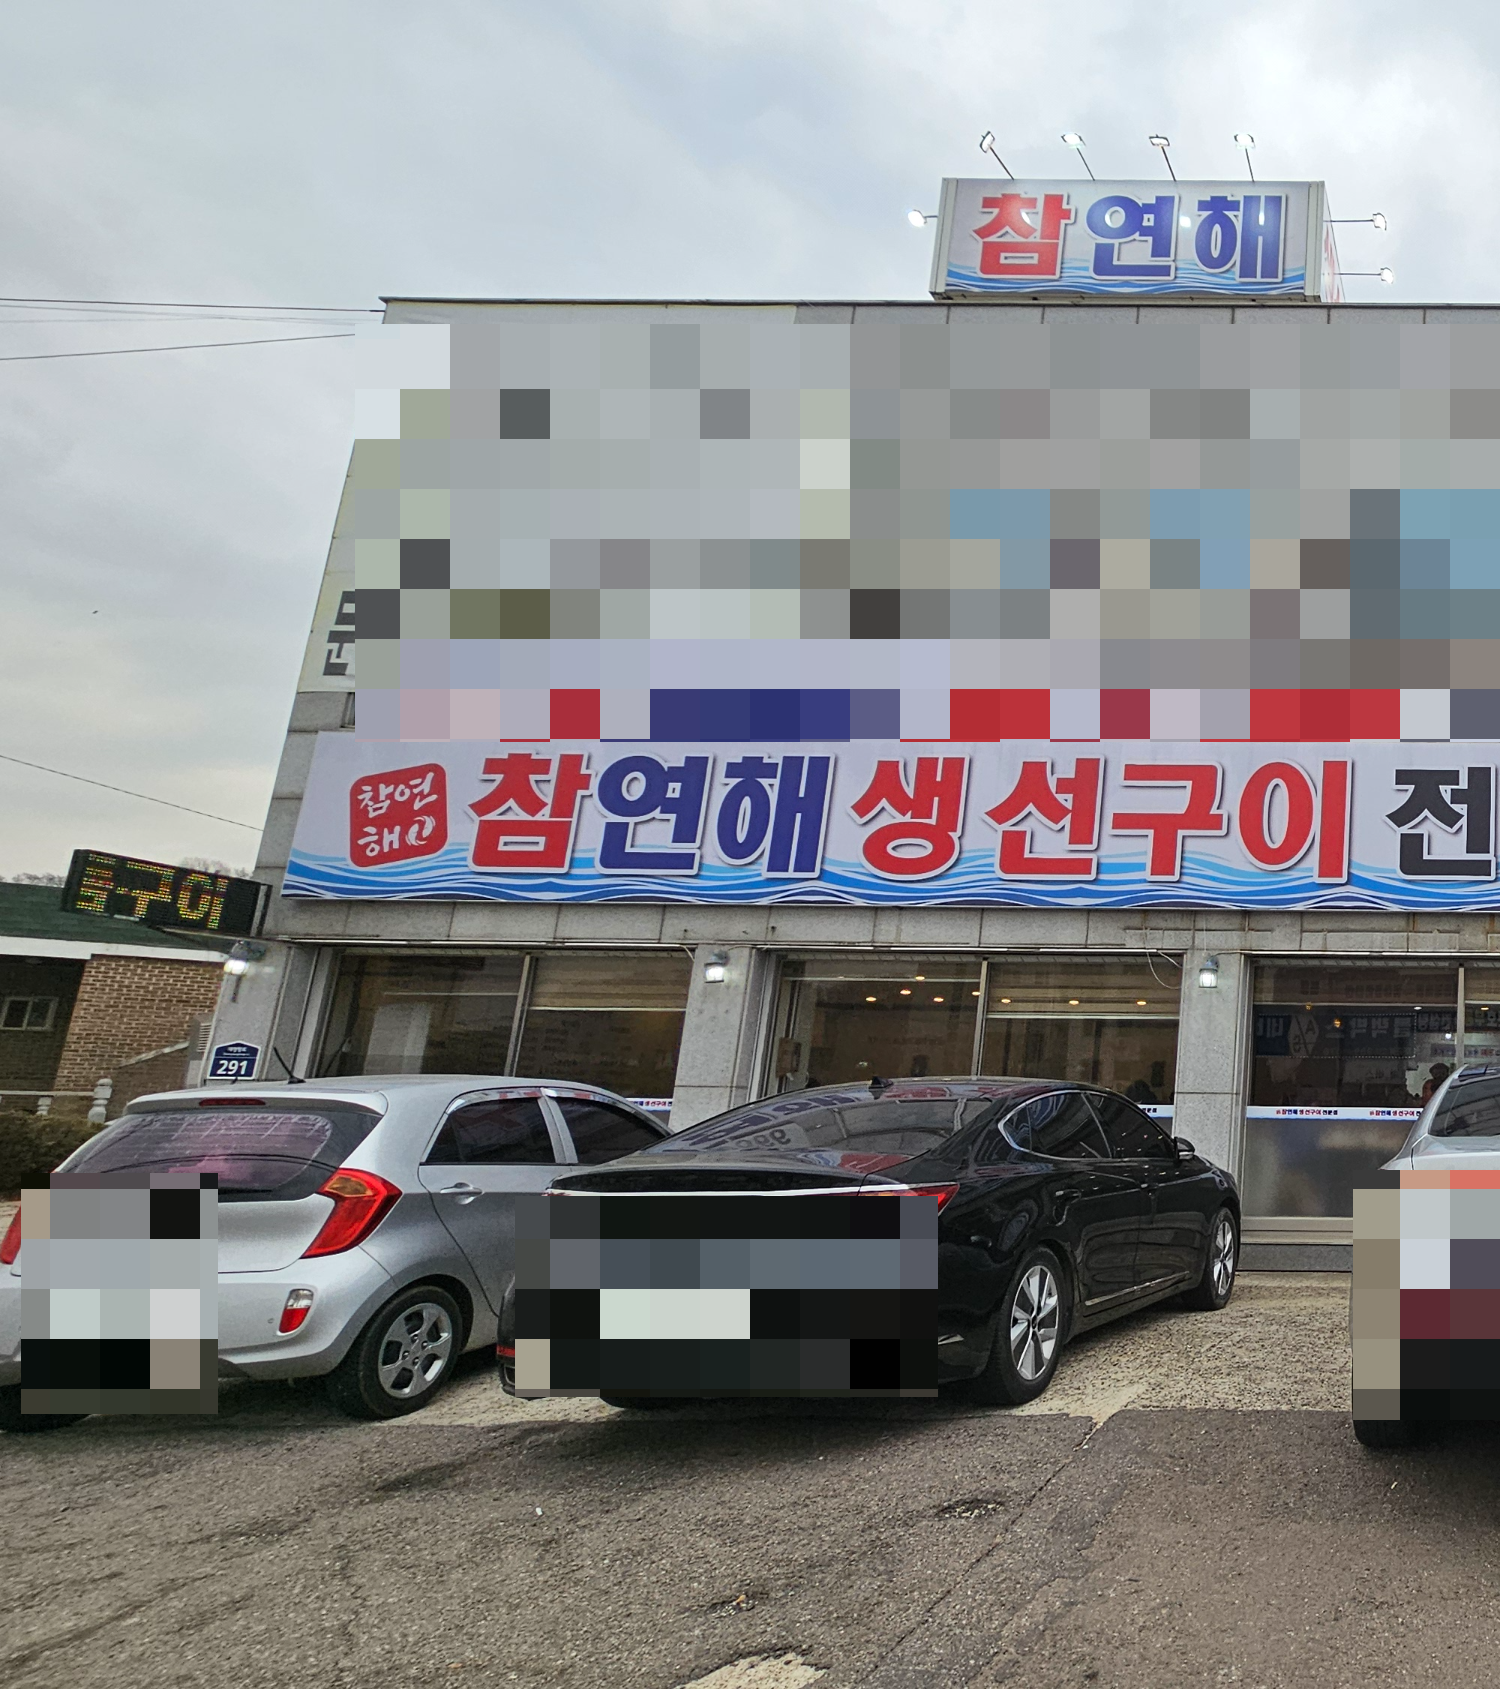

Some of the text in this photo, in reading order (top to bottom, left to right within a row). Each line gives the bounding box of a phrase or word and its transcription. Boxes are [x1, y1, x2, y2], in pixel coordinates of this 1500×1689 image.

[973, 192, 1284, 281] 참연해
[357, 771, 438, 818] 참연
[468, 752, 835, 876] 참연해
[851, 755, 1351, 880] 생선구이
[356, 825, 400, 856] 해
[216, 1060, 248, 1075] 291
